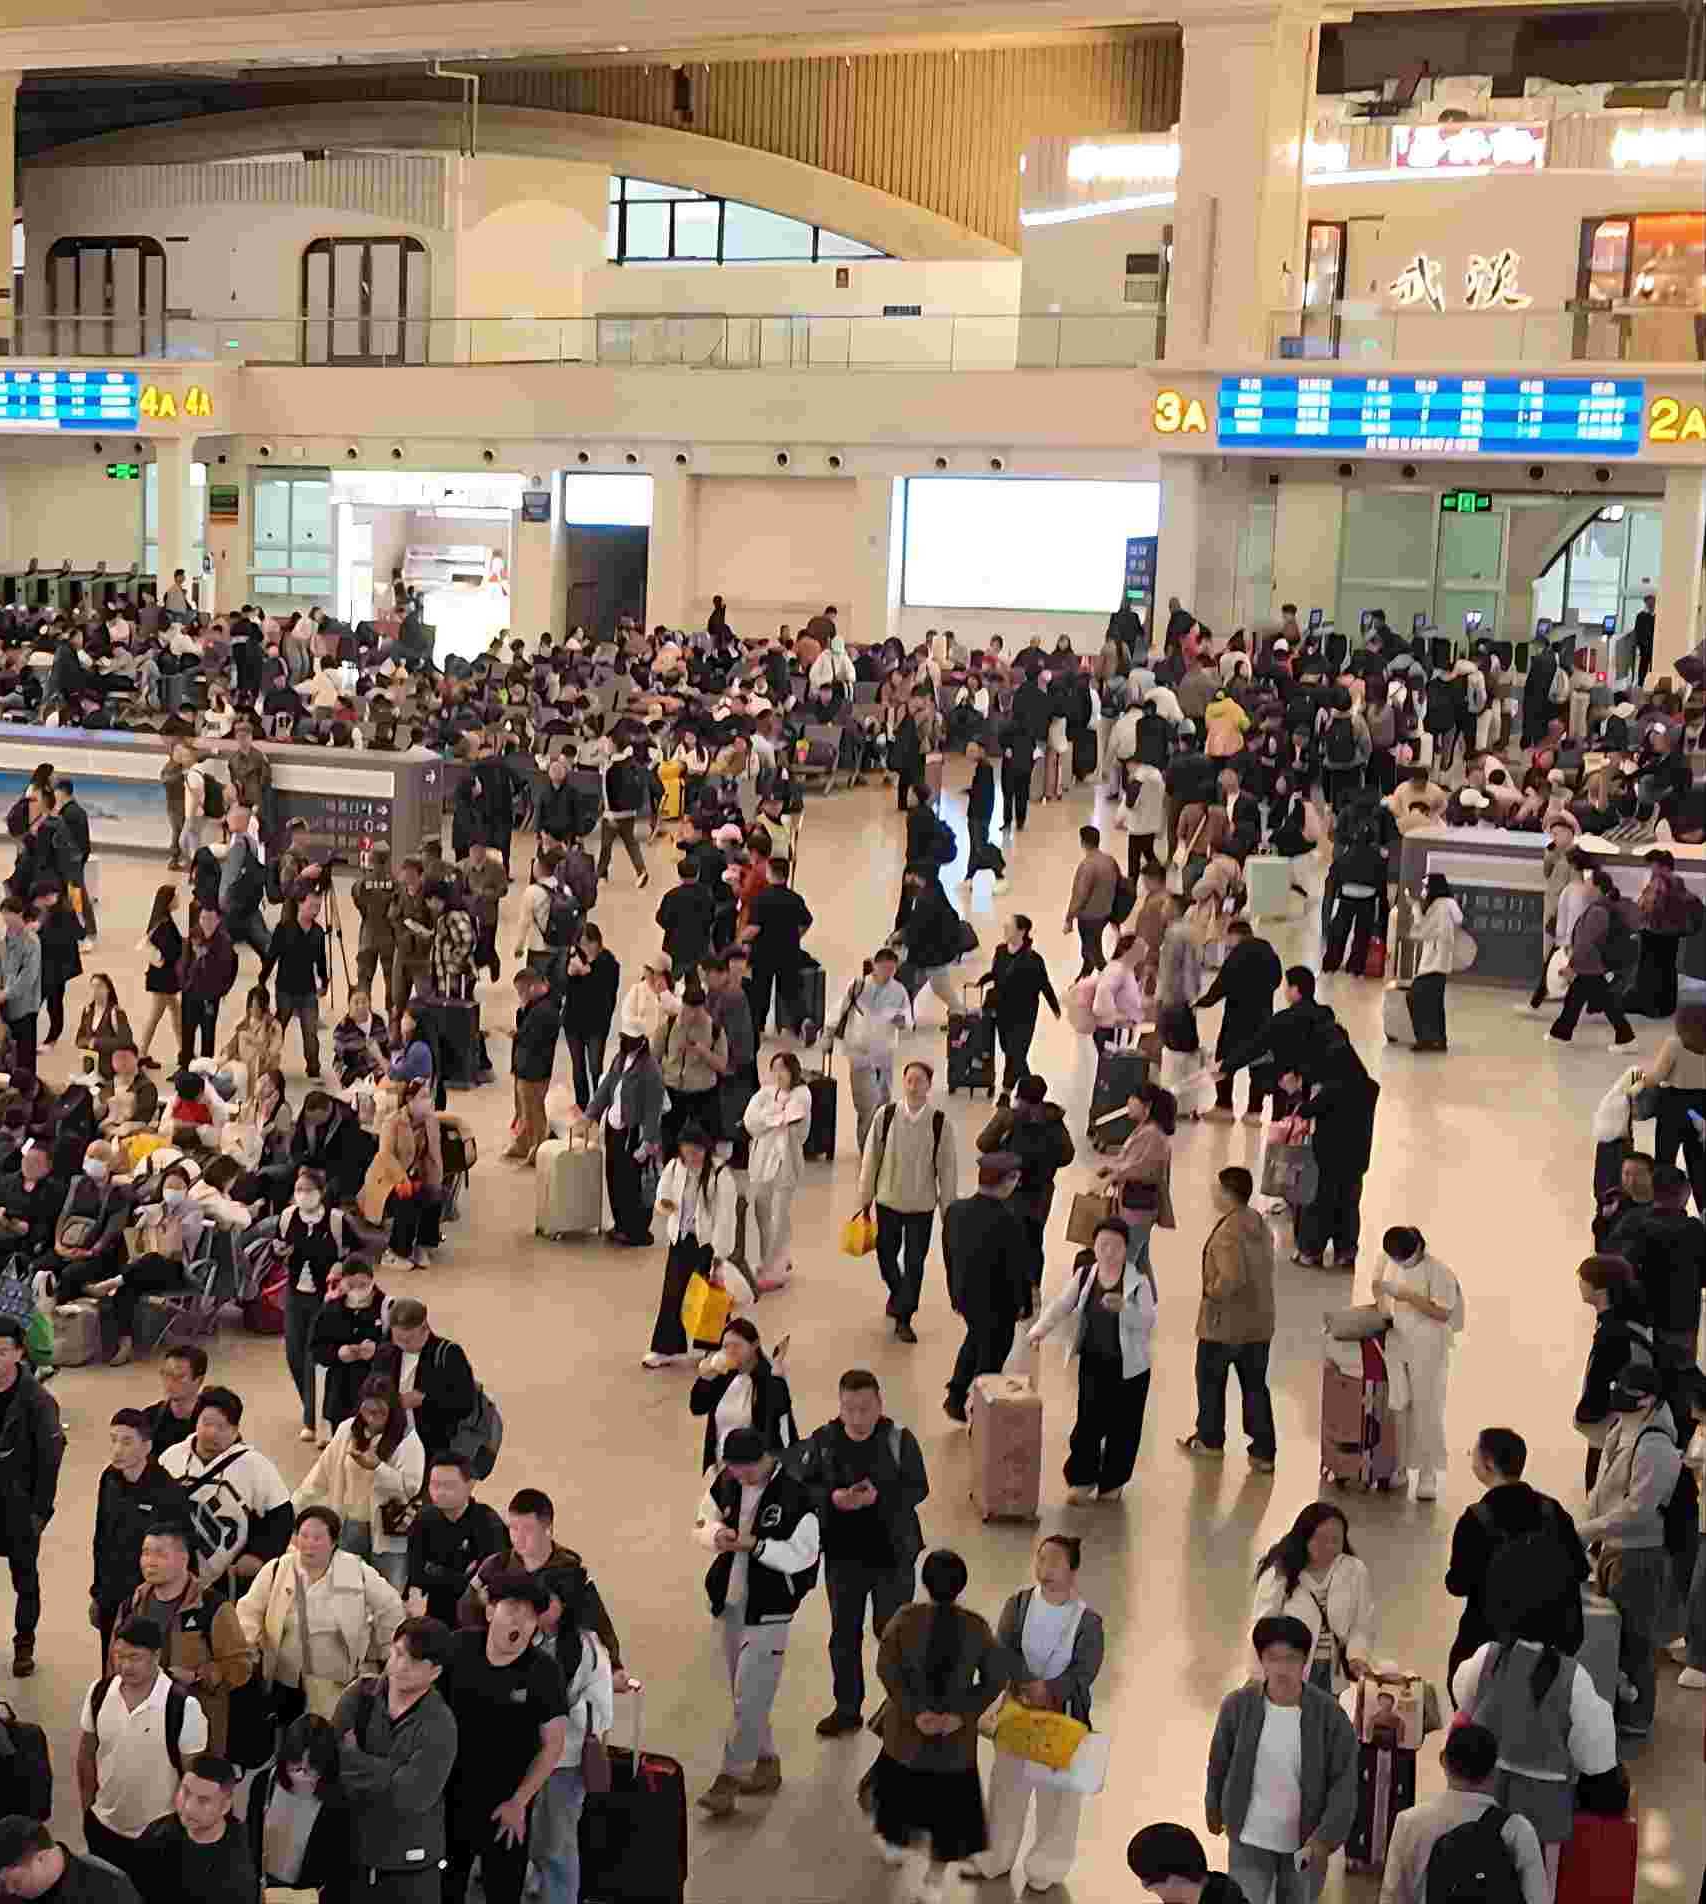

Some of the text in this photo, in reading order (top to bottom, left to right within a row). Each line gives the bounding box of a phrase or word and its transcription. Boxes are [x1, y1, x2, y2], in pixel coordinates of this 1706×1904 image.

[140, 385, 177, 417] 4A
[185, 386, 214, 417] 4A
[1154, 390, 1208, 433] 3A
[1649, 399, 1706, 440] 2A
